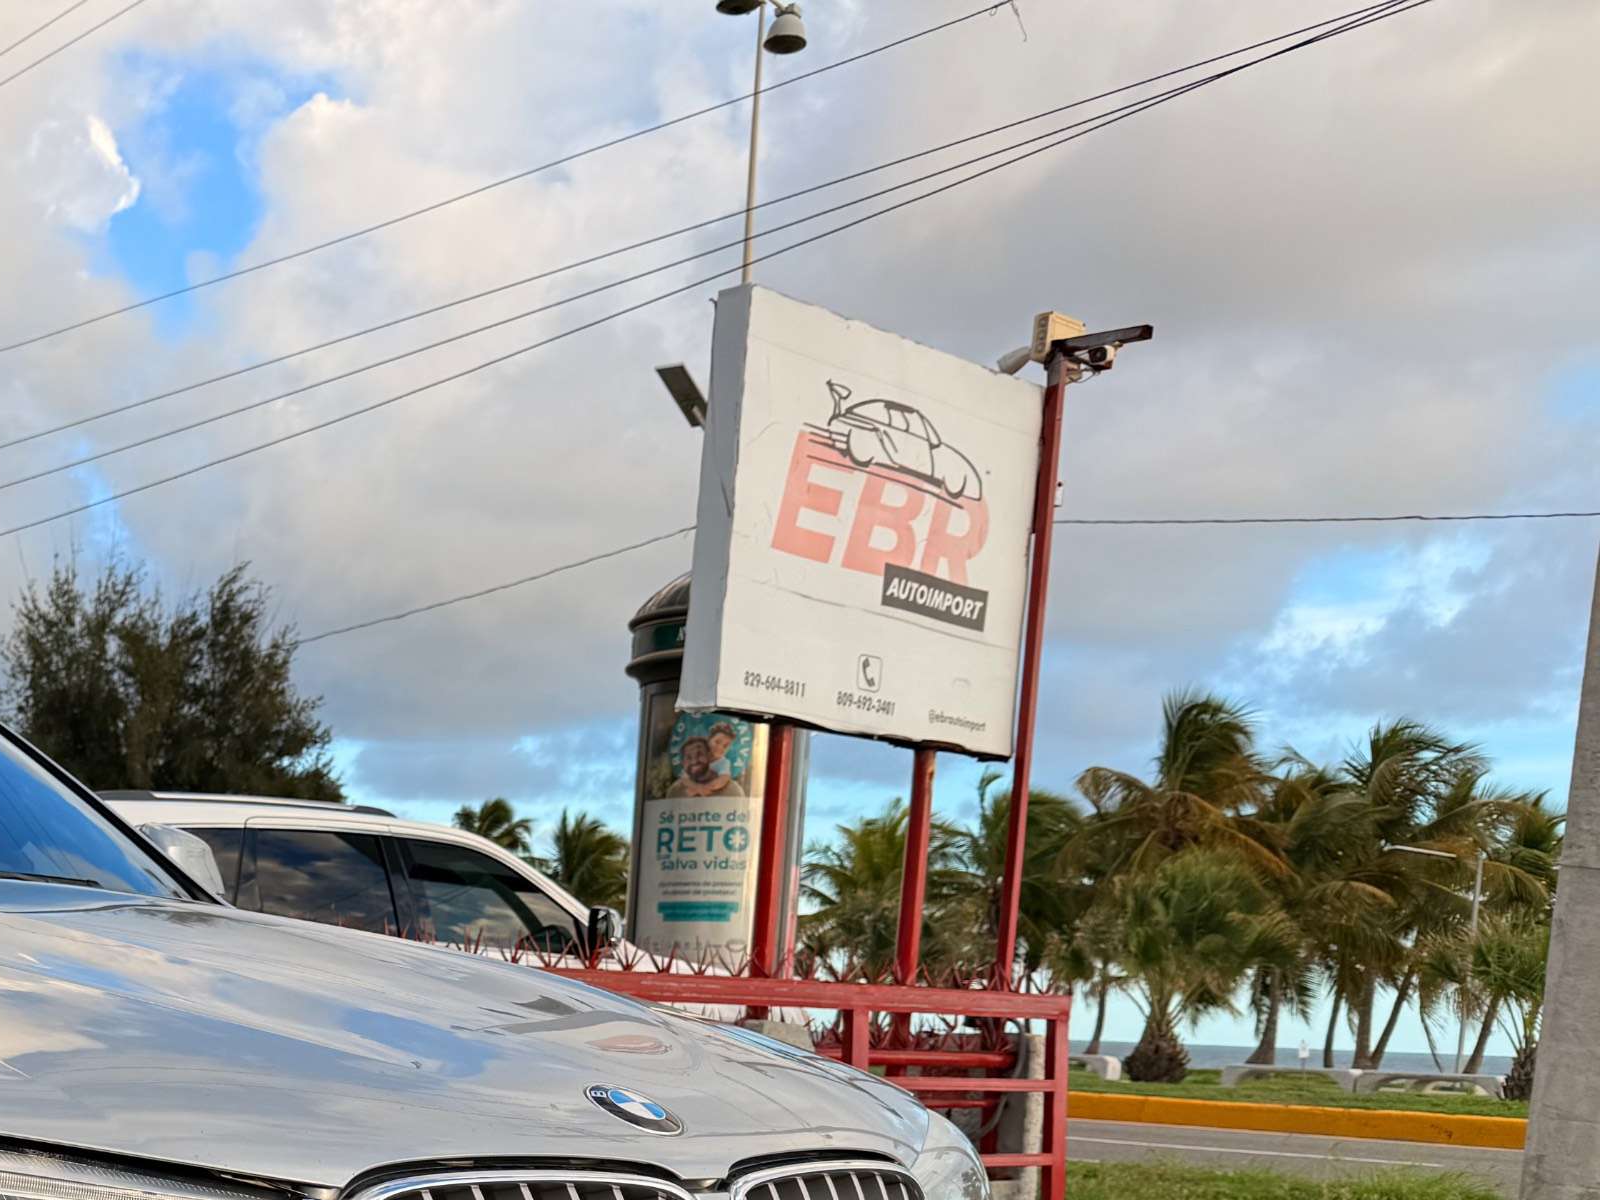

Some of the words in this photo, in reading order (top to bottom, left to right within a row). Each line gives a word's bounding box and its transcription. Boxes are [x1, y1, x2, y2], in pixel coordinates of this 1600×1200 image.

[771, 431, 990, 586] EBR
[886, 576, 984, 621] AUTOIMPORT
[743, 670, 806, 698] 829-604-8811
[678, 810, 722, 825] parte
[655, 825, 751, 853] RETO
[660, 858, 698, 871] salva
[702, 856, 747, 871] vidas
